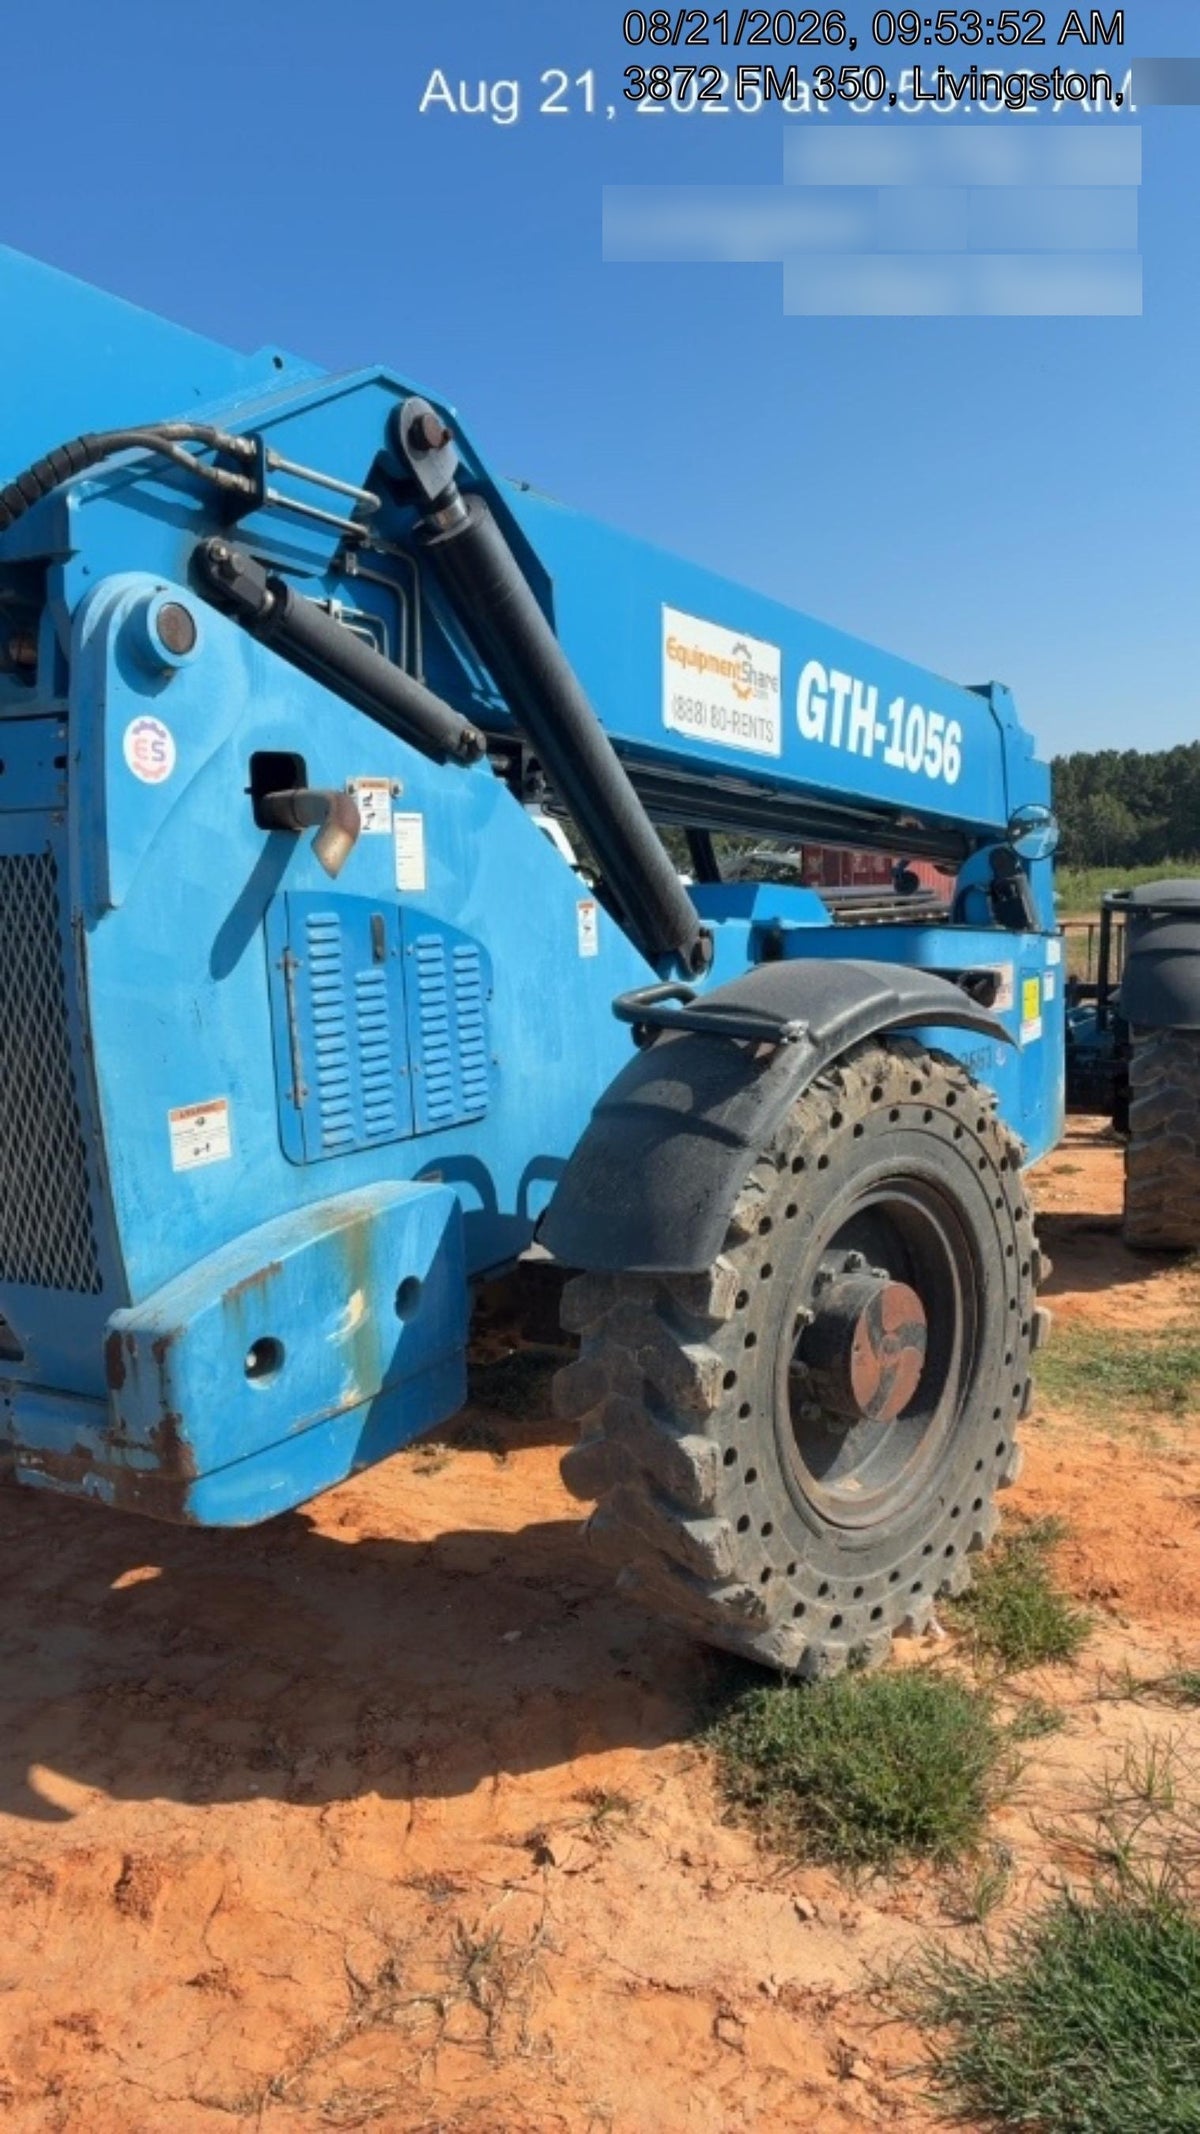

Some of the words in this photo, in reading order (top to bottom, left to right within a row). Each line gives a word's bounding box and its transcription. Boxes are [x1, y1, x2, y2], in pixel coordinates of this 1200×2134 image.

[666, 636, 778, 693] EquipmentShare
[711, 704, 774, 743] 80-RENTS
[796, 660, 962, 785] GTH-1056
[134, 738, 167, 762] ES
